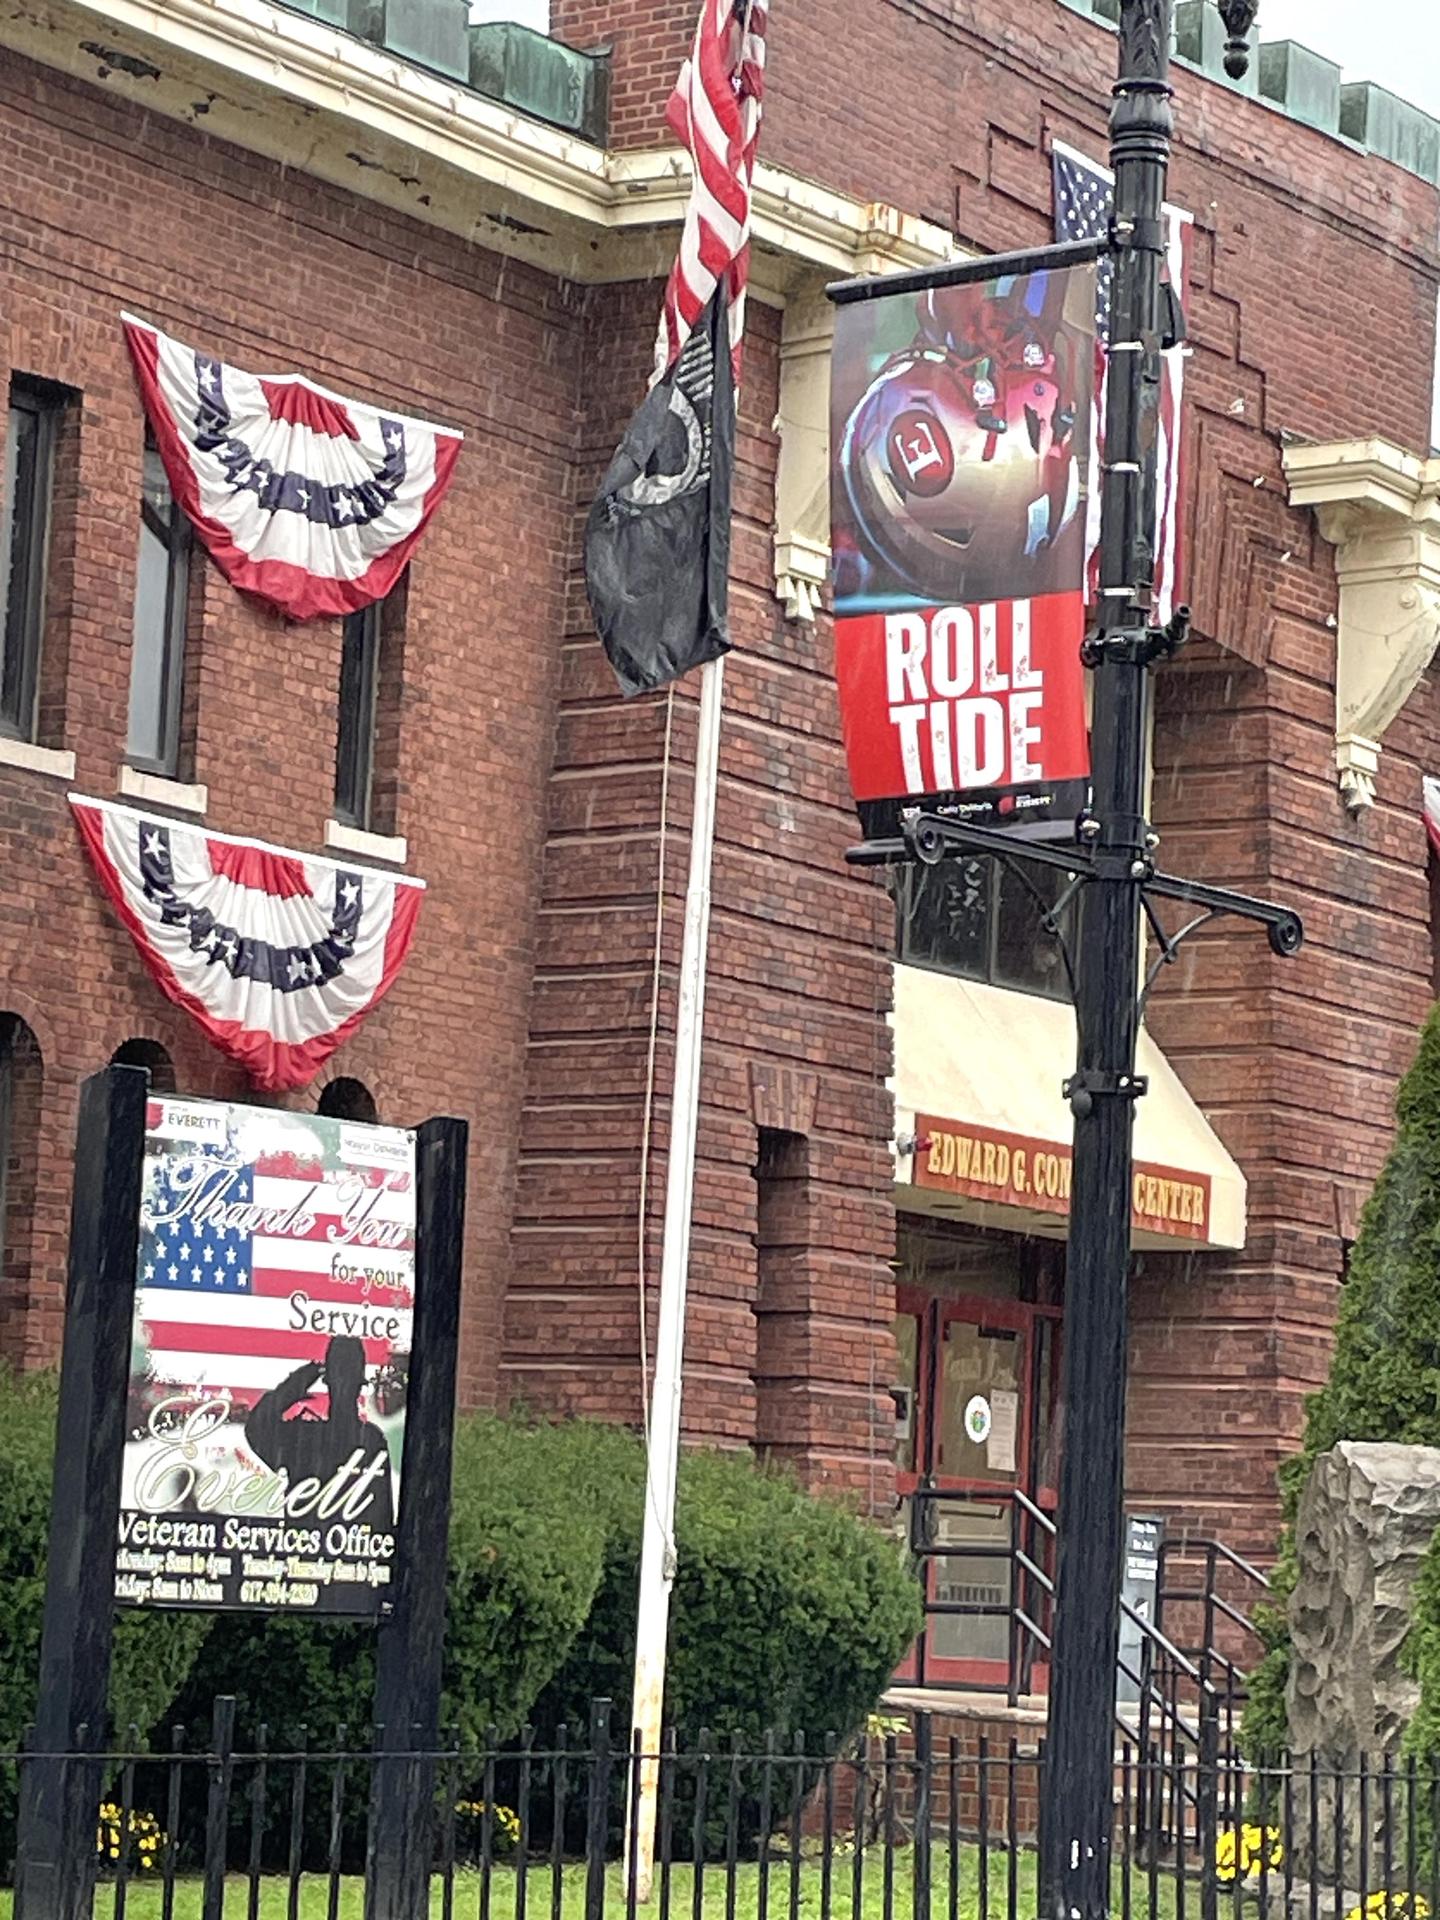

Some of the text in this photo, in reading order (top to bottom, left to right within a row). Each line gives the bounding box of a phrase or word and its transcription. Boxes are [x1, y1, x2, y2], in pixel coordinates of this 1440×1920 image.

[895, 422, 945, 482] E
[885, 598, 1042, 702] ROLL
[889, 691, 1042, 794] TIDE
[168, 1113, 220, 1130] EVERETT
[142, 1157, 408, 1246] Thank You
[928, 1131, 1009, 1187] EDWARD
[1013, 1150, 1031, 1194] G.
[1133, 1173, 1205, 1225] CENTER
[331, 1253, 405, 1294] for your
[289, 1292, 400, 1340] Service
[134, 1396, 388, 1521] Everett
[118, 1512, 395, 1557] Veteran Services Office
